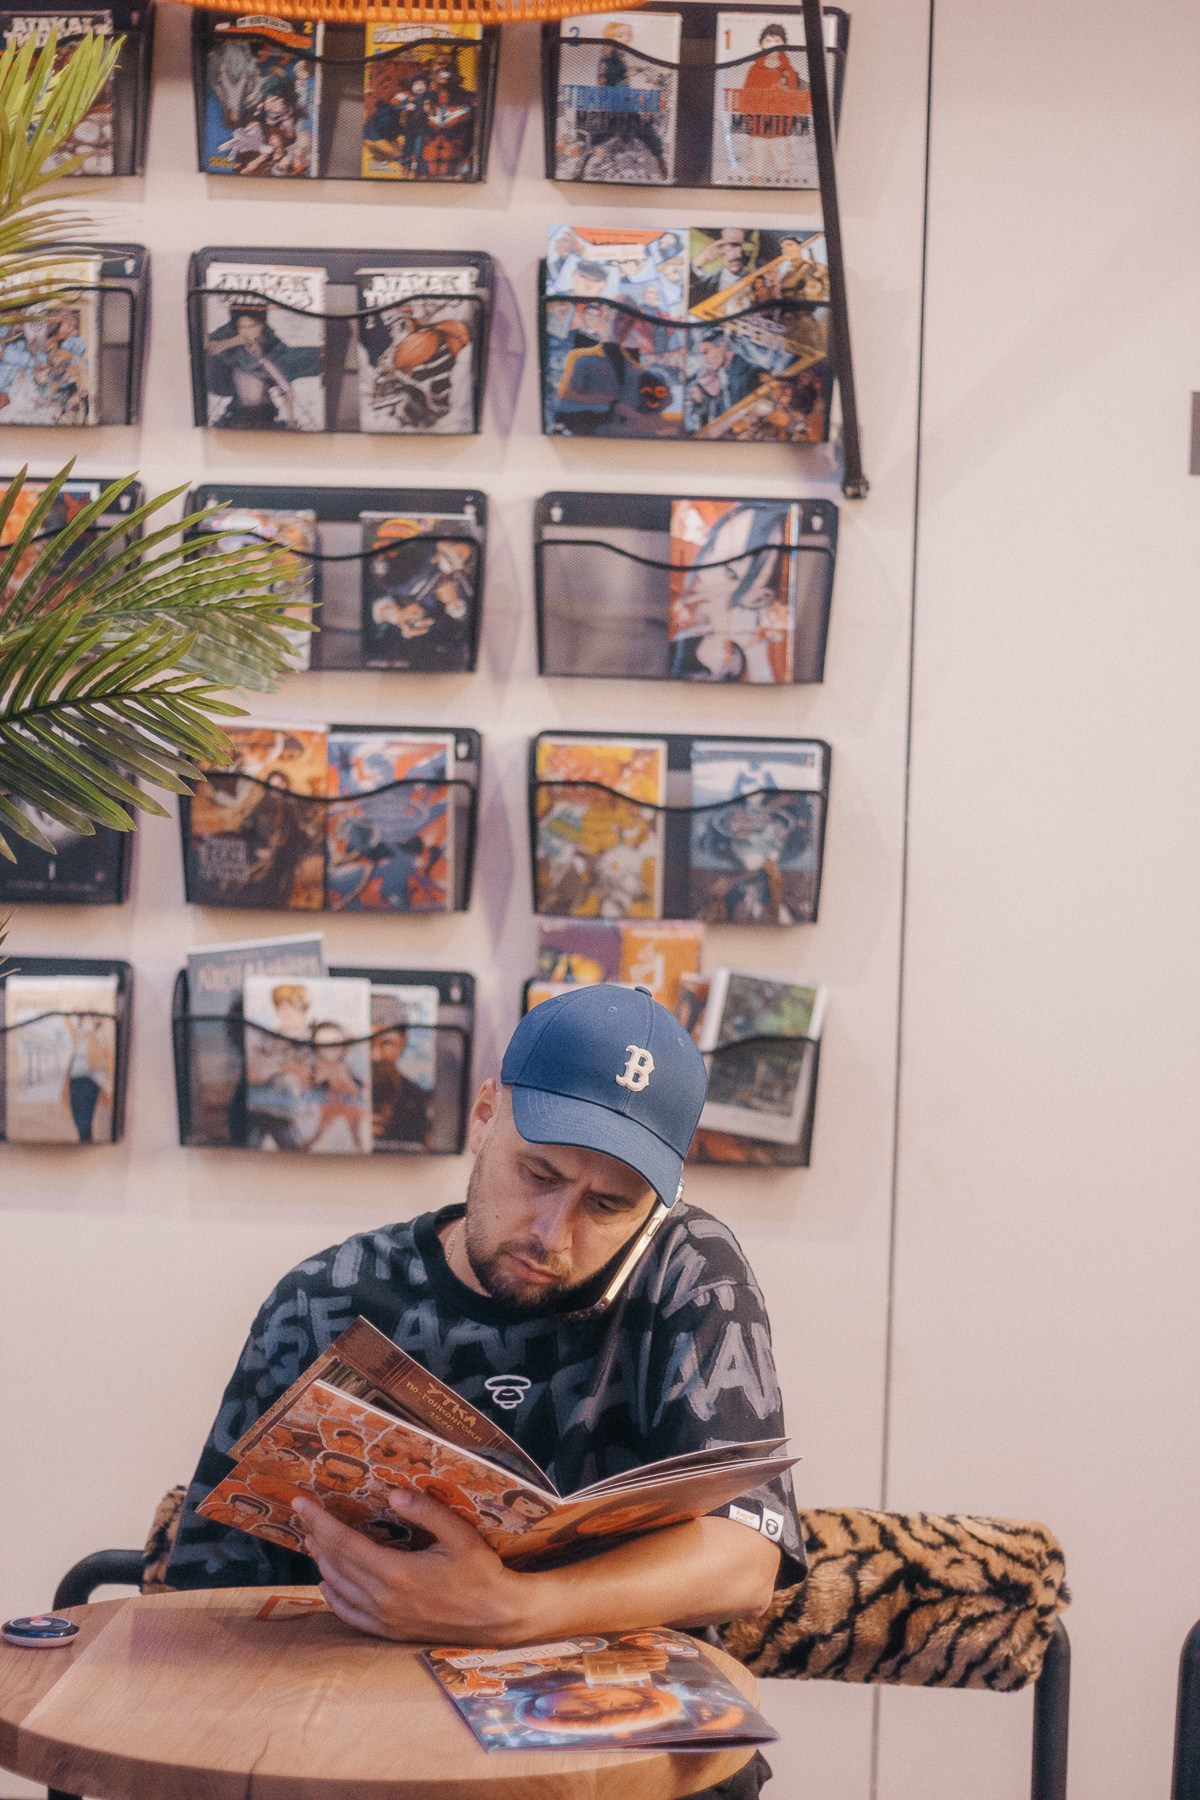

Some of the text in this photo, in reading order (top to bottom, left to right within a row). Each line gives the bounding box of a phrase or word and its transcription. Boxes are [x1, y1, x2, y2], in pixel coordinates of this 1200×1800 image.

[302, 21, 313, 34] 2
[724, 29, 731, 49] 1
[615, 1044, 655, 1092] B
[426, 1382, 477, 1428] УТКА
